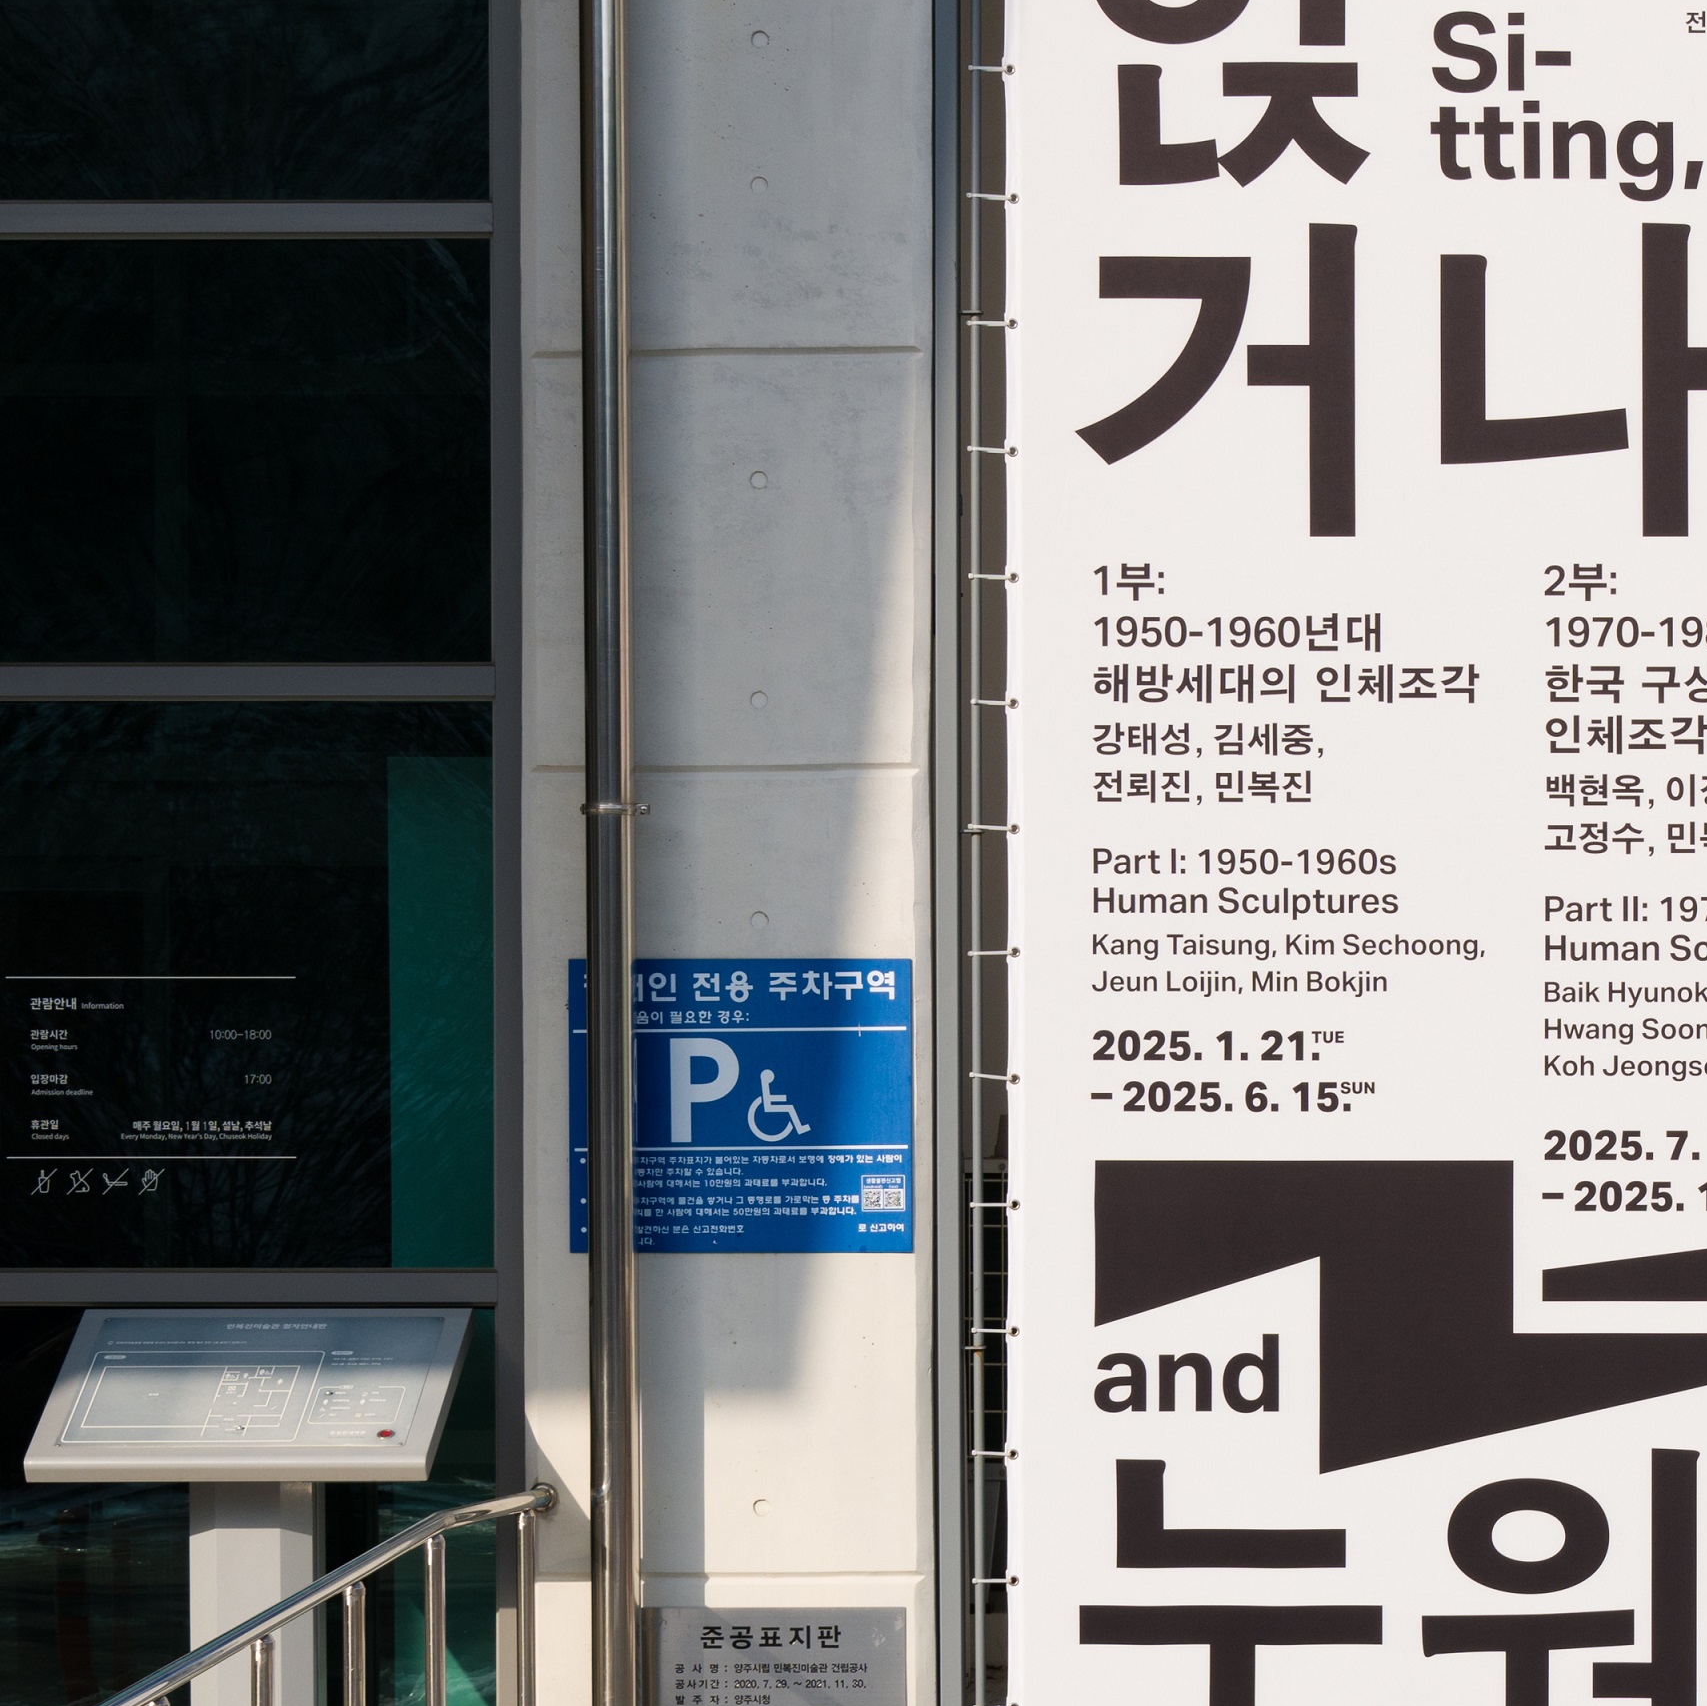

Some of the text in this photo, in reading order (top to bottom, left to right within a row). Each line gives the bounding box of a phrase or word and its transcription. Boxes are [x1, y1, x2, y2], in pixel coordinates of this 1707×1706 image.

[1431, 100, 1703, 201] tting,
[1094, 563, 1164, 601] 1부:
[1545, 564, 1616, 601] 2부:
[1095, 613, 1380, 652] 1950-1960년대
[1094, 664, 1479, 703] 해방세대의 인체조각
[1546, 664, 1624, 703] 한국
[1093, 723, 1323, 758] 강태성, 김세중,
[1093, 770, 1311, 805] 전뢰진, 민복진
[1547, 774, 1654, 809] 백현옥,
[1545, 822, 1654, 856] 고정수,
[1093, 848, 1160, 874] Part
[1199, 849, 1396, 874] 1950-1960s
[1094, 887, 1398, 920] Human Sculptures
[1545, 896, 1612, 922] Part
[1093, 934, 1484, 960] Kang Taisung, Kim Sechoong,
[1545, 935, 1659, 961] Human
[693, 971, 753, 1002] 전용
[769, 970, 895, 1000] 주차구역
[1092, 971, 1387, 997] Jeun Loijin, Min Bokjin
[1545, 982, 1600, 1002] Baik
[30, 997, 125, 1011] 관람안내 Information
[670, 1010, 713, 1025] 필요한
[717, 1009, 750, 1025] 경우:
[30, 1029, 68, 1040] 관람시간
[1545, 1019, 1633, 1045] Hwang
[30, 1043, 59, 1052] Opening
[1093, 1030, 1202, 1061] 2025.
[1216, 1031, 1248, 1060] 1.
[1545, 1055, 1594, 1076] Koh
[30, 1073, 69, 1085] 입장마감
[30, 1088, 94, 1096] Admission deadline
[244, 1073, 273, 1085] 17:00
[670, 1038, 739, 1142] P
[1123, 1081, 1232, 1112] 2025.
[1245, 1081, 1278, 1112] 6.
[30, 1119, 59, 1130] 휴관일
[31, 1132, 70, 1142] Closed days
[120, 1132, 139, 1142] Every
[139, 1132, 168, 1142] Monday,
[203, 1132, 219, 1142] Day,
[218, 1132, 247, 1140] Chuseok
[247, 1132, 273, 1141] Holiday
[132, 1120, 152, 1132] 매주
[152, 1120, 184, 1133] 월요일,
[185, 1120, 201, 1132] 1월
[203, 1120, 221, 1133] 1일,
[221, 1120, 244, 1133] 설날,
[1544, 1130, 1653, 1161] 2025.
[1666, 1131, 1699, 1160] 7.
[1575, 1181, 1684, 1212] 2025.
[666, 1206, 771, 1217] 사람에 대해서는 50만원의
[693, 1224, 745, 1234] 신고전화번호
[858, 1222, 905, 1233] 로 신고하여
[1094, 1334, 1279, 1413] and
[701, 1626, 841, 1649] 준공표지판
[733, 1662, 868, 1674] 양주시립 민복진미술관 건립공사
[734, 1679, 760, 1689] 2020.
[762, 1679, 772, 1689] 7.
[775, 1679, 790, 1689] 29.
[805, 1679, 831, 1689] 2021.
[834, 1679, 849, 1689] 11.
[851, 1678, 867, 1689] 30.
[734, 1694, 771, 1705] 양주시청
